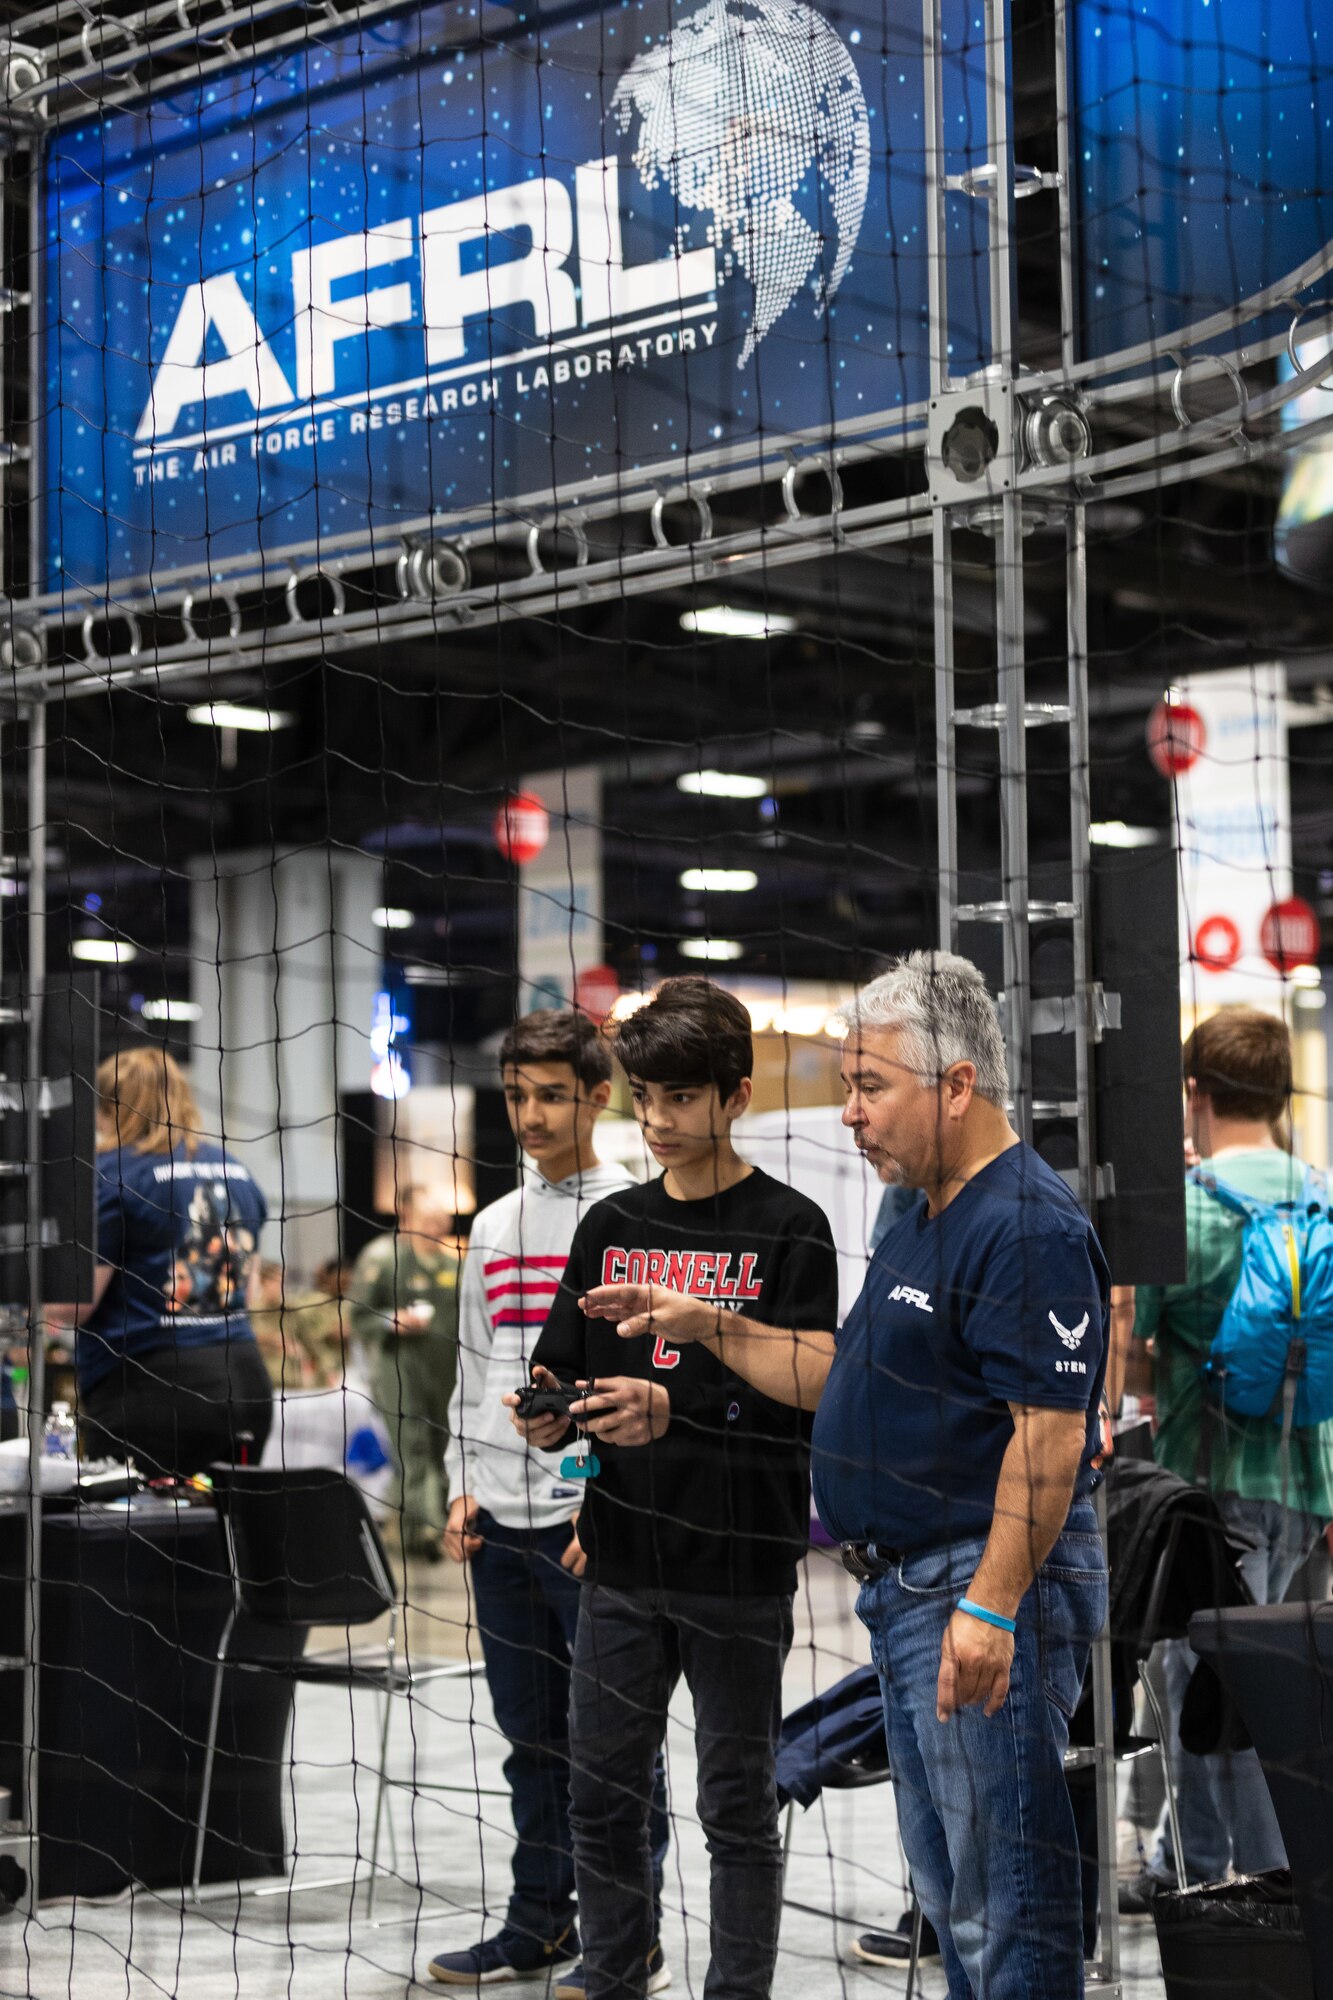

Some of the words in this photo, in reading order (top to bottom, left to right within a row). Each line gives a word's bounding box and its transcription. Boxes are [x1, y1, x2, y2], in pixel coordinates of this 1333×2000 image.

[134, 155, 717, 440] AFRL
[133, 456, 180, 486] THE
[193, 443, 237, 472] AIR
[251, 419, 335, 458] FORCE
[350, 377, 499, 434] RESEARCH
[516, 321, 718, 394] LABORATORY
[601, 1245, 764, 1300] CORNELL
[887, 1284, 934, 1313] AFRL
[1055, 1360, 1087, 1375] STEM
